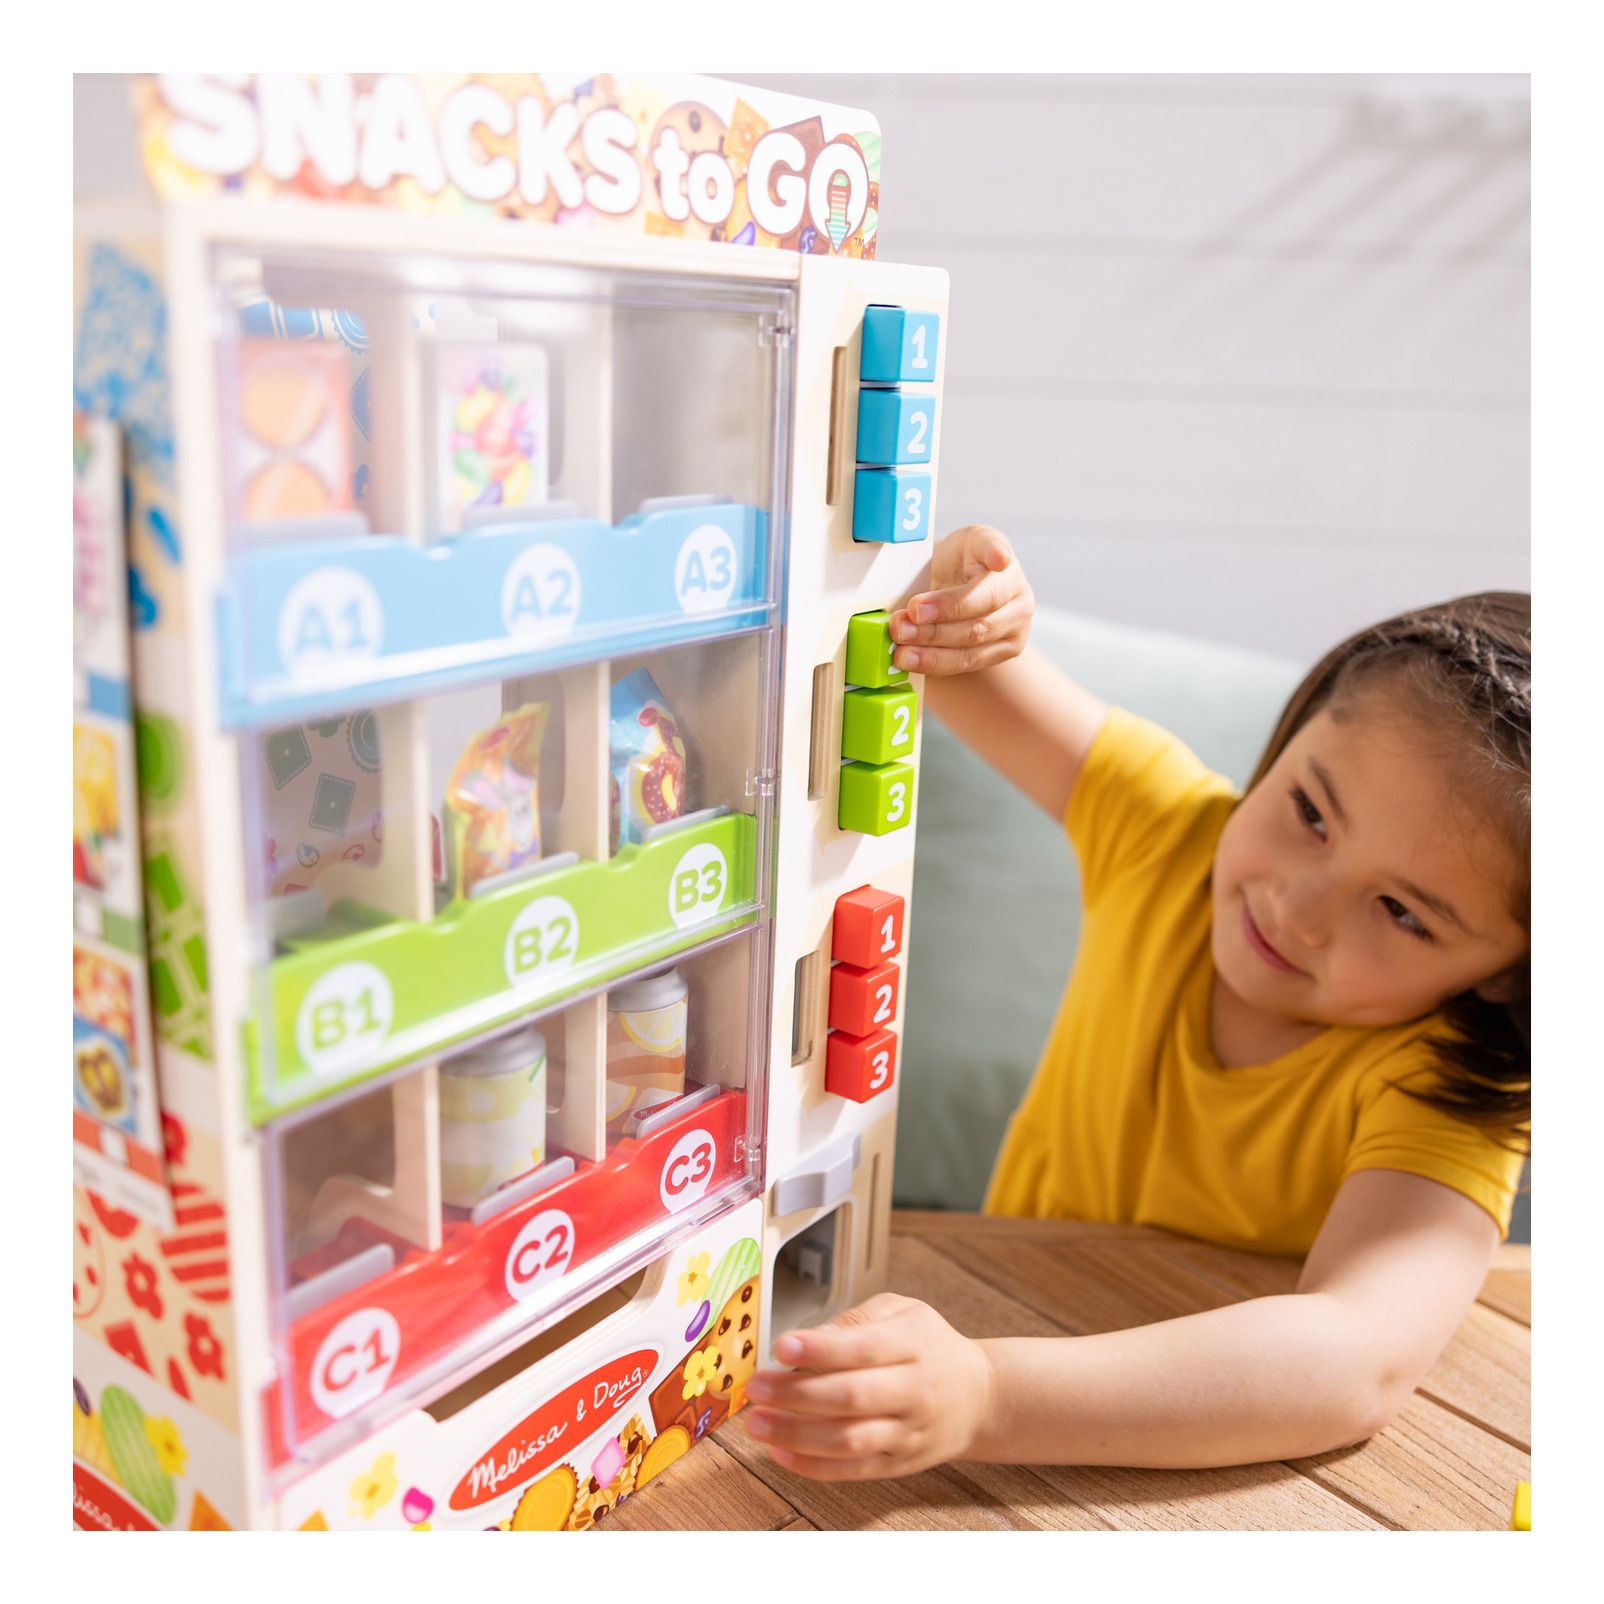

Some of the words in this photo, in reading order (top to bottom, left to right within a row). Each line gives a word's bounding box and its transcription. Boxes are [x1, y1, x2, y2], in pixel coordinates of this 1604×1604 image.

[158, 73, 641, 213] SNACKS
[653, 126, 734, 224] to
[747, 131, 869, 240] GO
[911, 325, 928, 368] 1
[907, 411, 927, 454] 2
[902, 488, 922, 530] 3
[509, 569, 573, 622] A2
[681, 545, 731, 594] A3
[296, 599, 371, 654] A1
[892, 705, 911, 746] 2
[886, 782, 906, 822] 3
[675, 859, 723, 913] B3
[514, 915, 574, 973] B2
[880, 914, 895, 952] 1
[311, 984, 383, 1052] B1
[875, 983, 893, 1022] 2
[870, 1051, 889, 1087] 3
[665, 1142, 712, 1195] C3
[513, 1225, 569, 1284] C2
[323, 1324, 391, 1393] C1
[467, 1421, 568, 1498] Melissa
[576, 1399, 587, 1421] &
